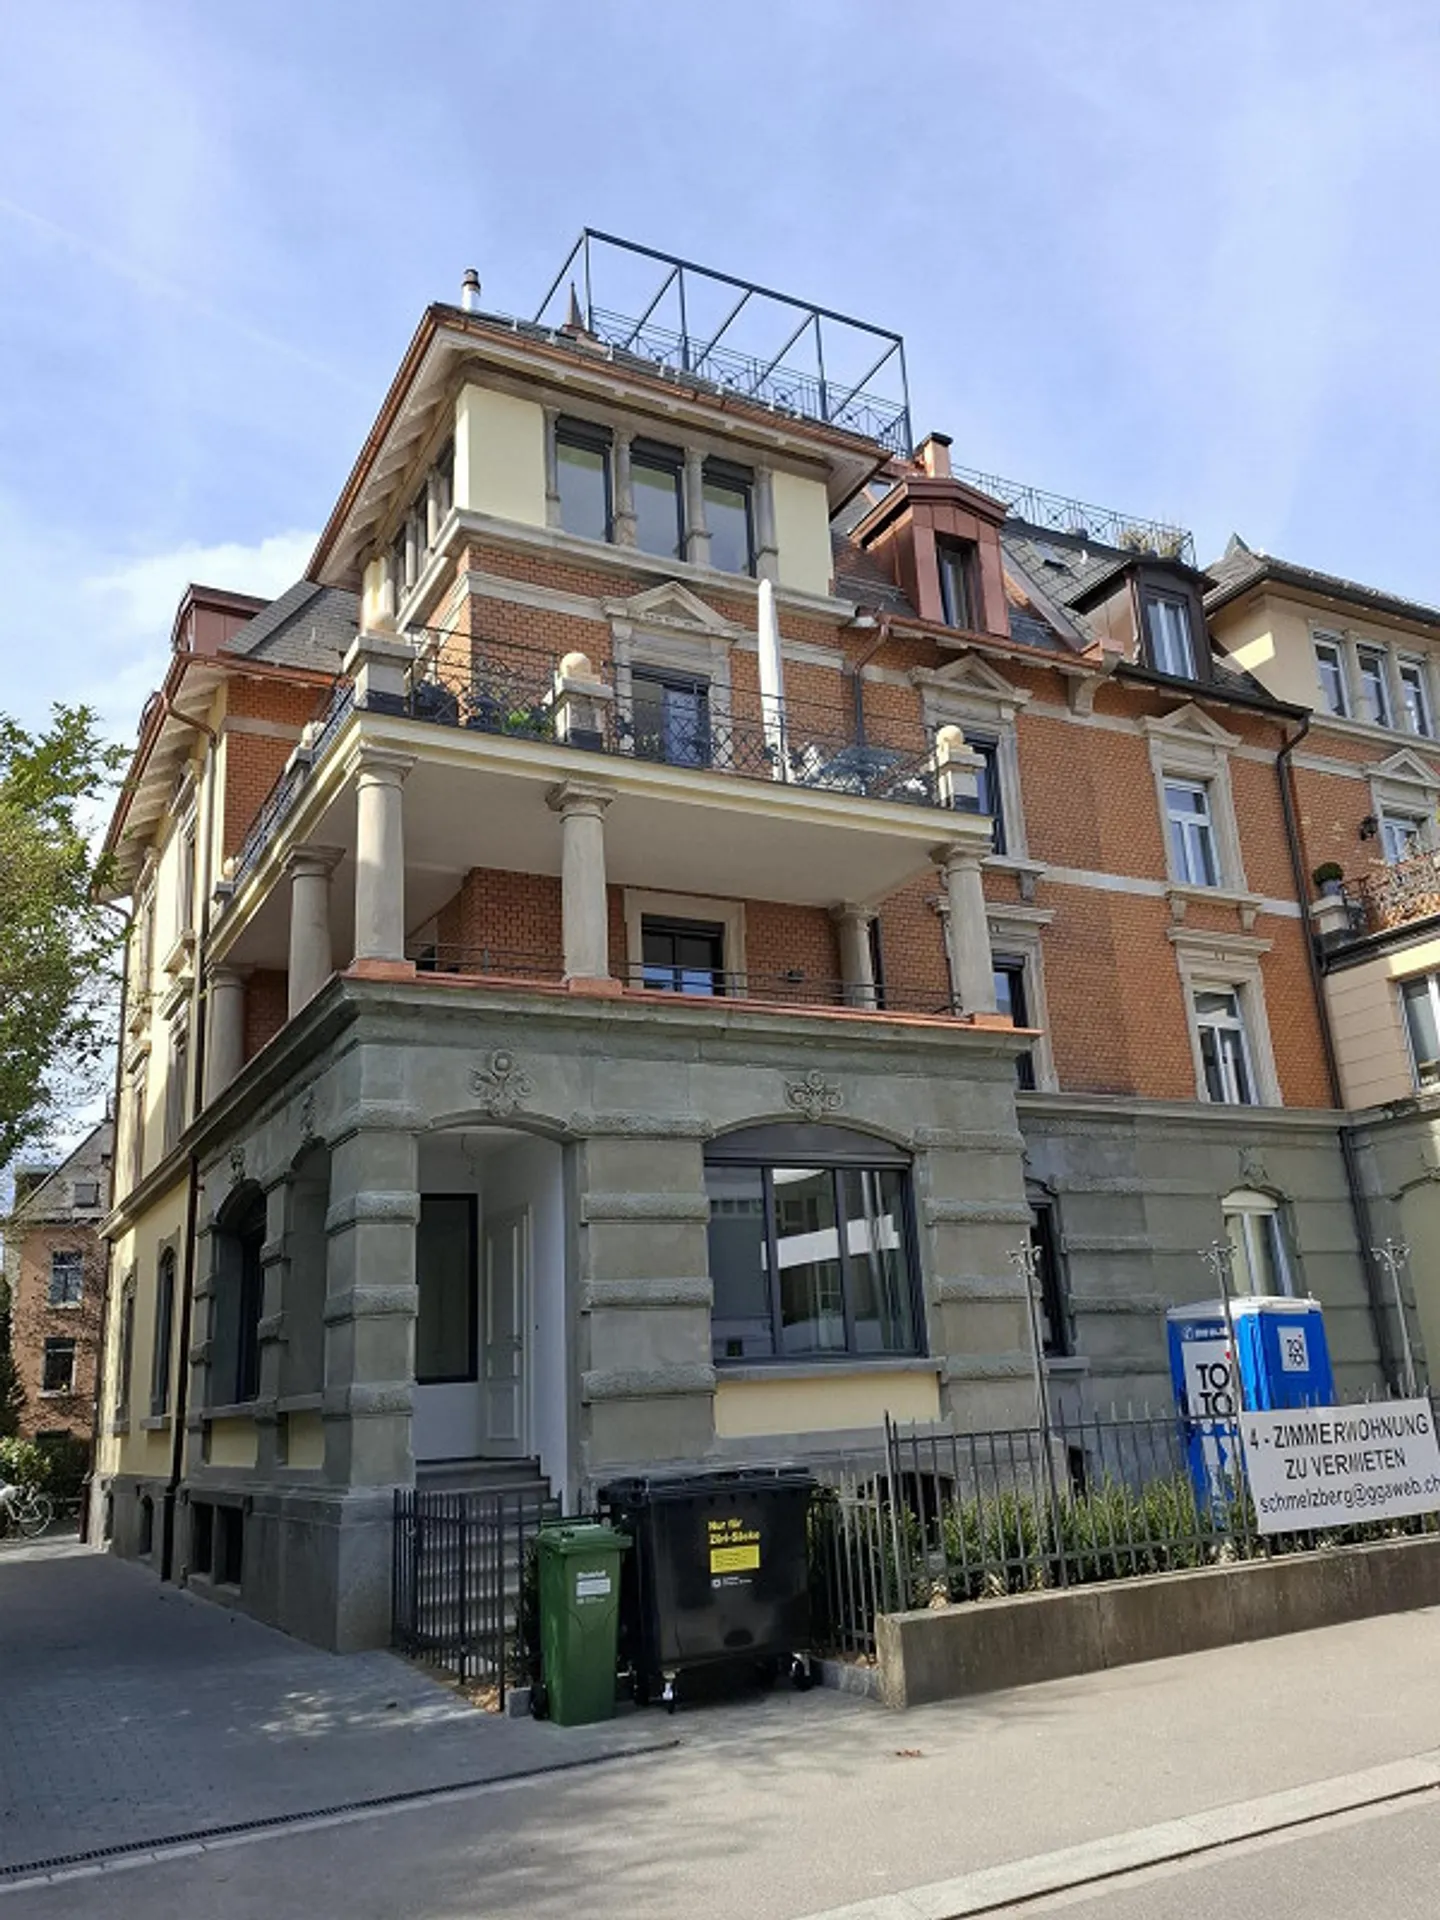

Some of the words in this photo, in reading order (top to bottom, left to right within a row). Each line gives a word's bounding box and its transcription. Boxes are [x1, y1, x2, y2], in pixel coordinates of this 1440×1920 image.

[1195, 1363, 1232, 1390] TO
[1250, 1427, 1259, 1450] 4
[1273, 1413, 1429, 1449] ZIMMERWOHNUNG
[1284, 1456, 1307, 1480] ZU
[1310, 1447, 1407, 1478] VERMIETEN
